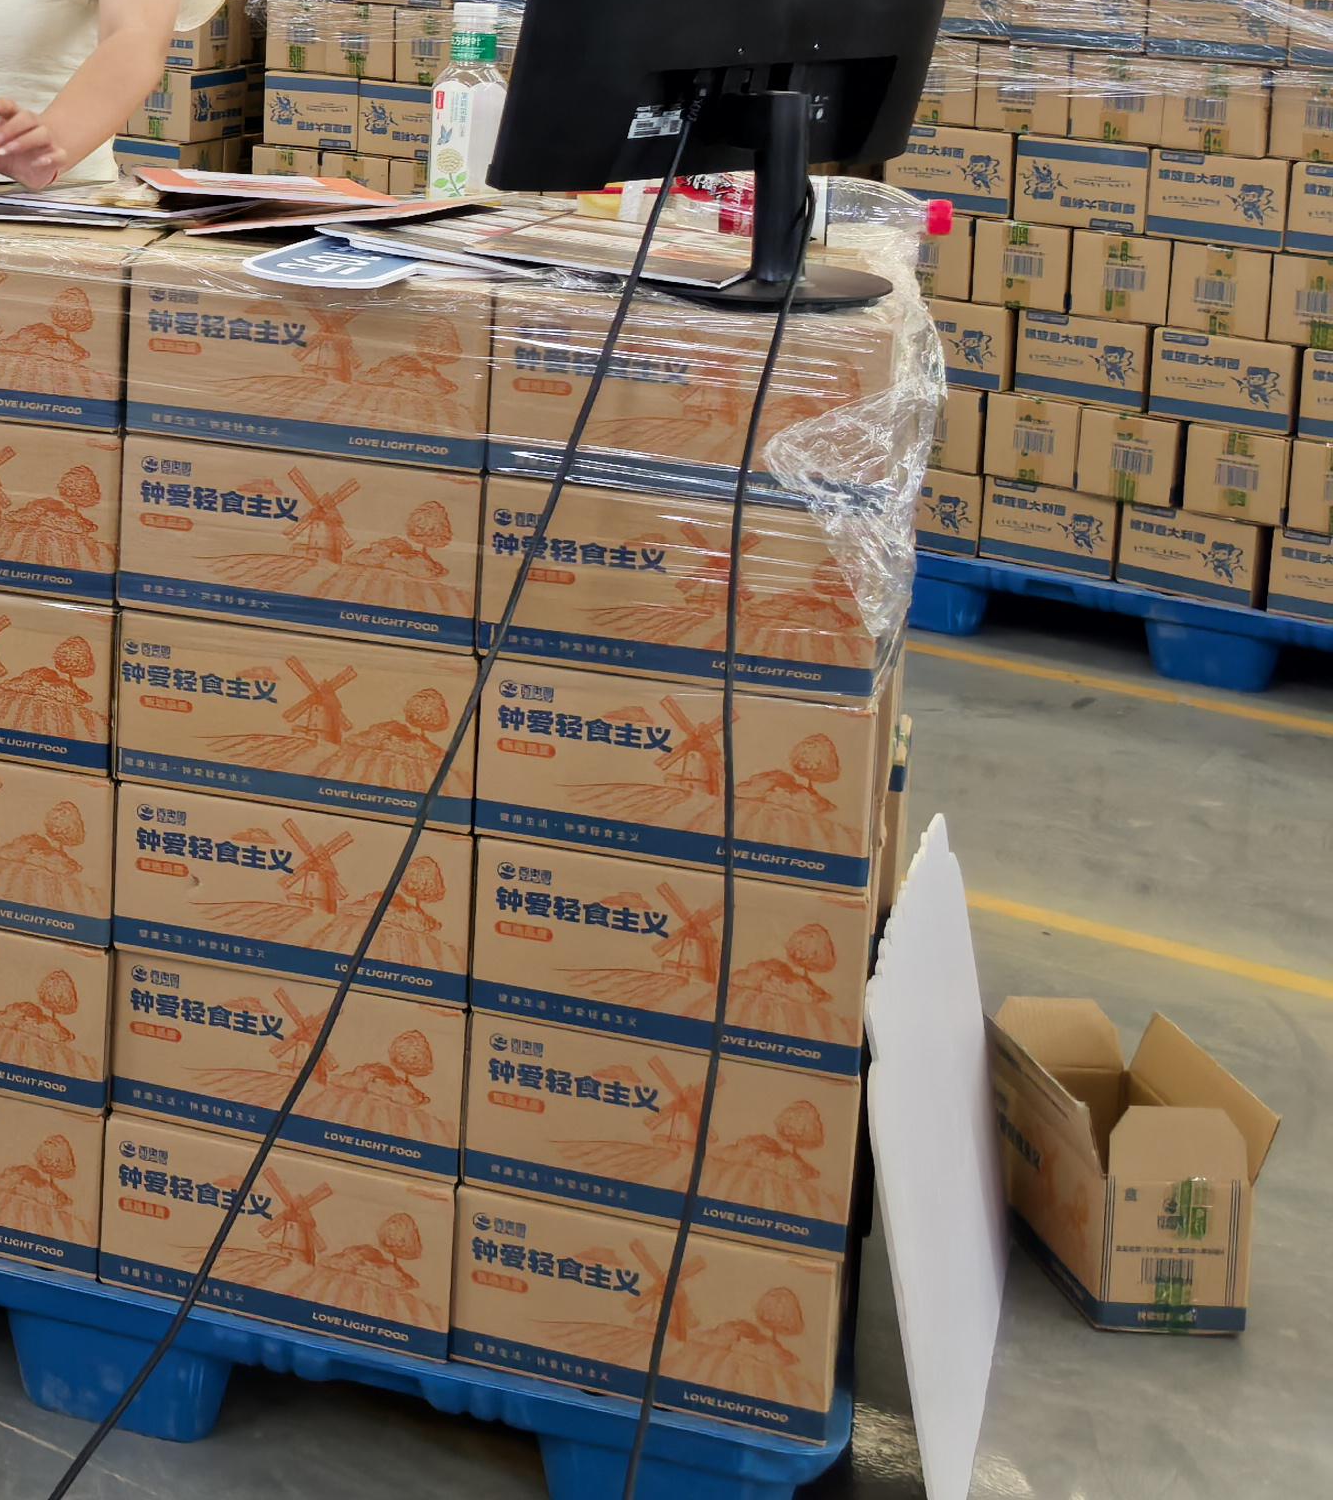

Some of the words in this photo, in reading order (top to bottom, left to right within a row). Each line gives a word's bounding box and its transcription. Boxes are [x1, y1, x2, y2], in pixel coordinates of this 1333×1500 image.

[149, 311, 305, 346] 钟爱轻食主义
[18, 400, 52, 412] LIGHT
[52, 404, 83, 415] FOOD
[348, 436, 379, 448] LOVE
[379, 440, 415, 451] LIGHT
[415, 443, 449, 456] FOOD
[142, 482, 298, 521] 钟爱轻食主义
[10, 570, 43, 581] LIGHT
[43, 574, 73, 585] FOOD
[339, 611, 369, 623] LOVE
[370, 616, 406, 628] LIGHT
[406, 620, 439, 632] FOOD
[123, 664, 277, 702] 钟爱轻食主义
[498, 707, 671, 752] 钟爱轻食主义
[6, 738, 38, 749] LIGHT
[38, 743, 68, 754] FOOD
[138, 829, 292, 873] 钟爱轻食主义
[496, 887, 668, 937] 钟爱轻食主义
[131, 989, 283, 1039] 钟爱轻食主义
[489, 1059, 658, 1111] 钟爱轻食主义
[324, 1131, 354, 1145] LOVE
[354, 1138, 389, 1152] LIGHT
[389, 1145, 422, 1159] FOOD
[703, 1208, 735, 1222] LOVE
[736, 1214, 774, 1228] LIGHT
[774, 1222, 810, 1236] FOOD
[2, 1236, 34, 1250] LIGHT
[34, 1244, 64, 1257] FOOD
[472, 1238, 640, 1296] 钟爱轻食主义
[312, 1312, 342, 1326] LOVE
[342, 1319, 377, 1333] LIGHT
[377, 1327, 409, 1342] FOOD
[683, 1391, 715, 1406] LOVE
[716, 1399, 754, 1414] LIGHT
[754, 1408, 789, 1423] FOOD
